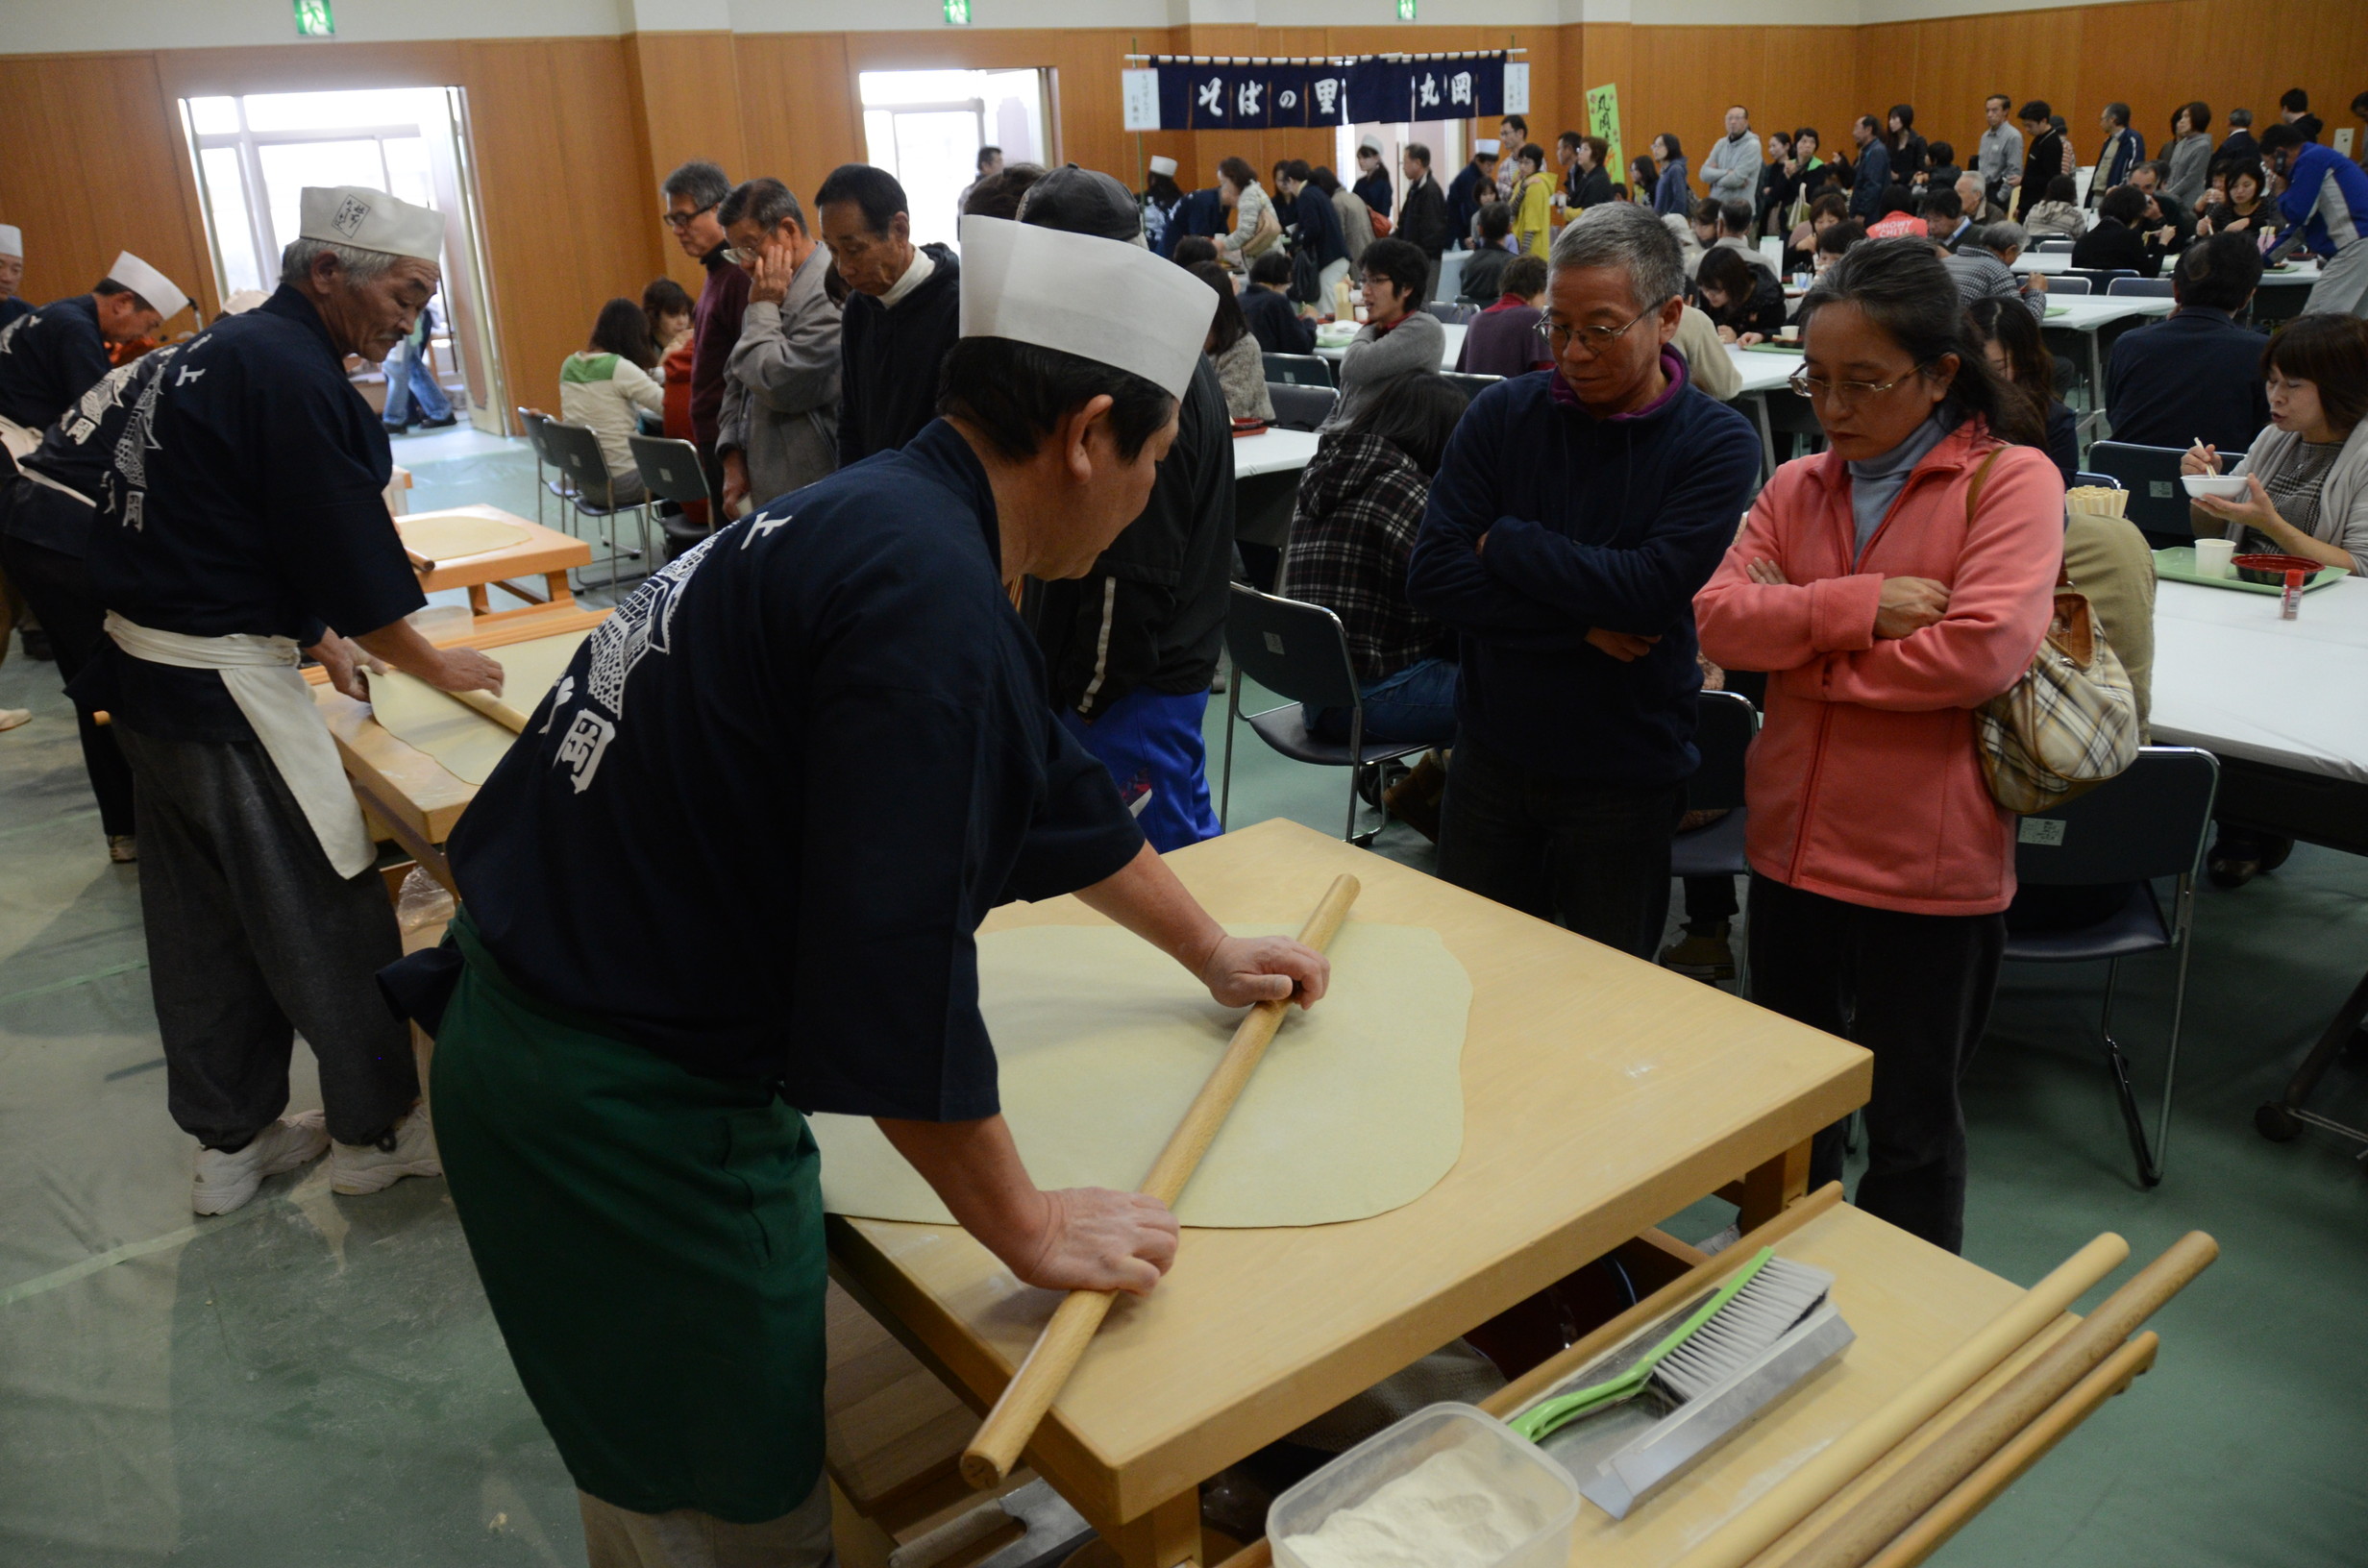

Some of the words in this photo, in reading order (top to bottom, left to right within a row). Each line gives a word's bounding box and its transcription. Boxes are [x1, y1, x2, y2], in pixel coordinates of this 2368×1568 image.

[1198, 77, 1339, 117] そばの里
[1419, 71, 1472, 108] 丸岡
